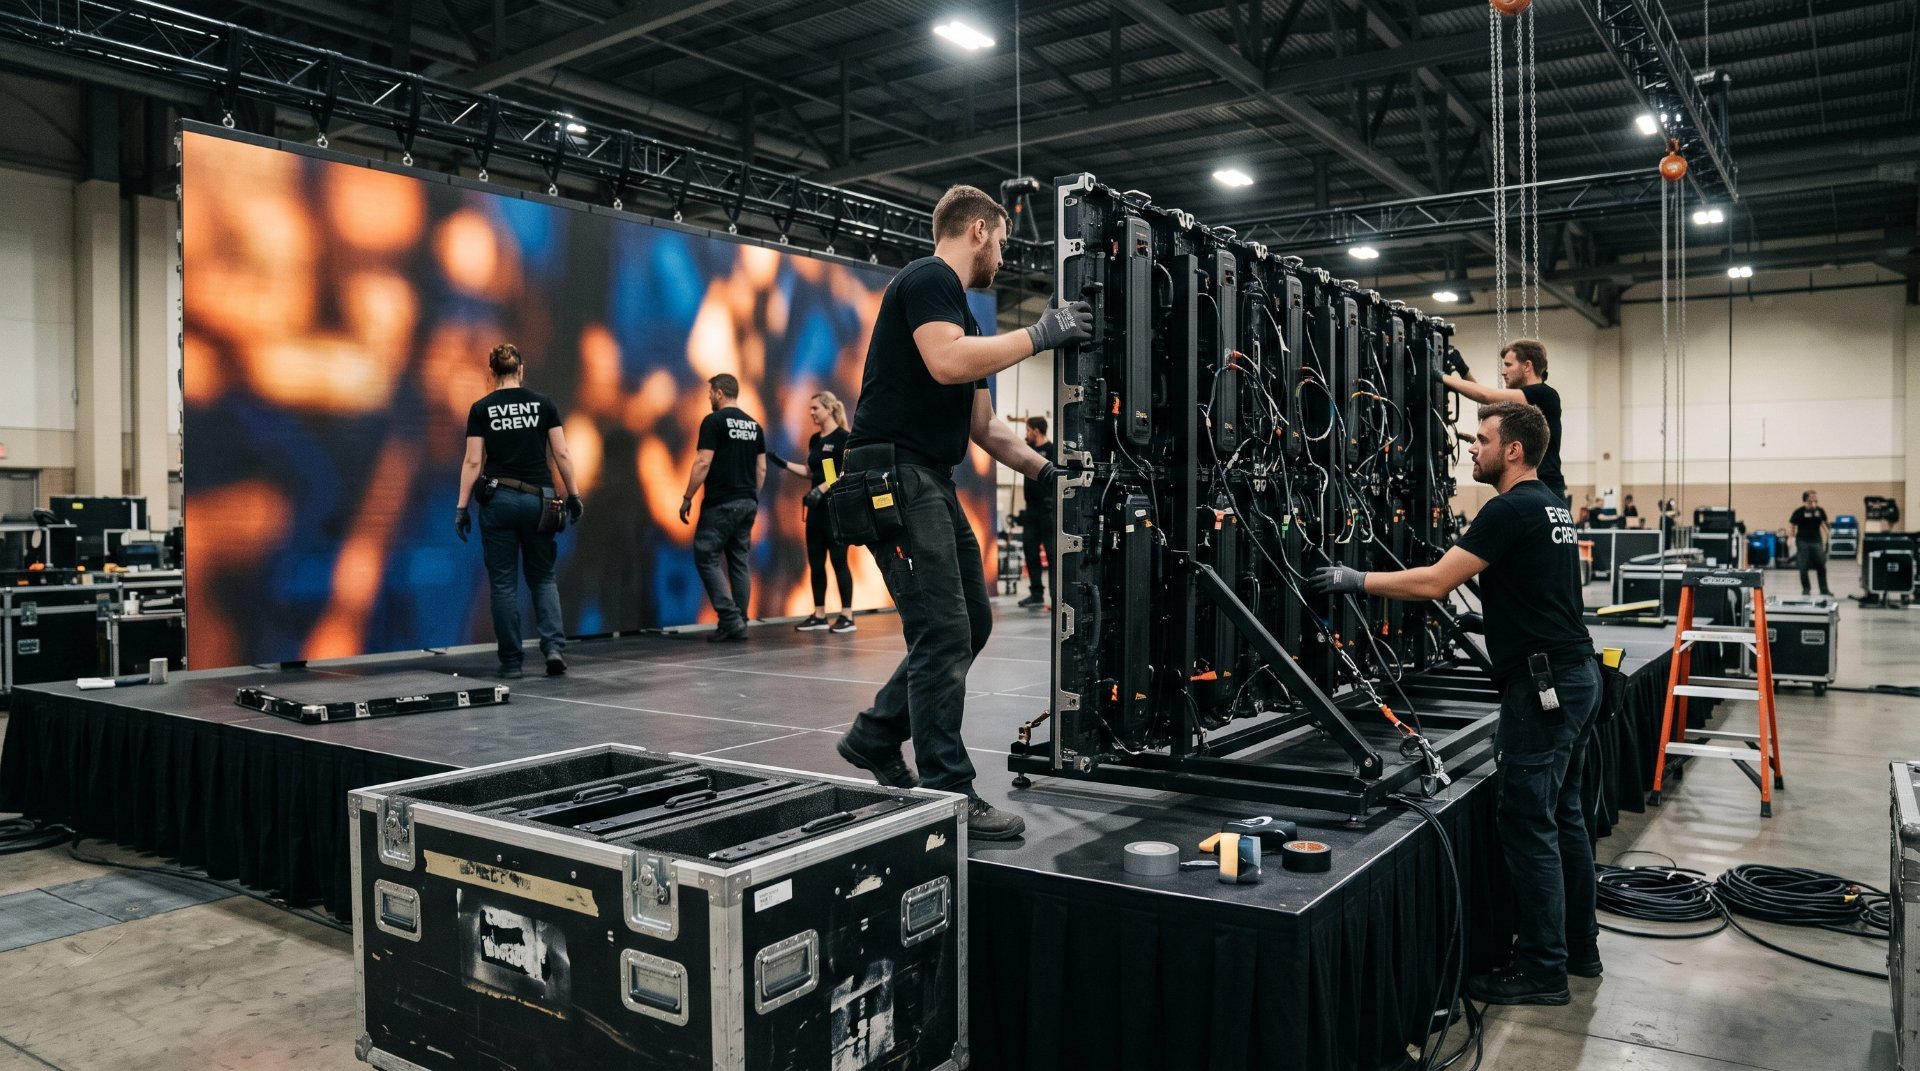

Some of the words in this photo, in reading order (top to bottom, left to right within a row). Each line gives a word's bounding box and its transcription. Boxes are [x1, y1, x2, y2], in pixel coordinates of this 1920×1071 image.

[488, 402, 540, 418] EVENT
[490, 415, 539, 431] CREW
[726, 418, 757, 430] EVENT
[729, 428, 757, 441] CREW
[1551, 526, 1578, 544] CREW
